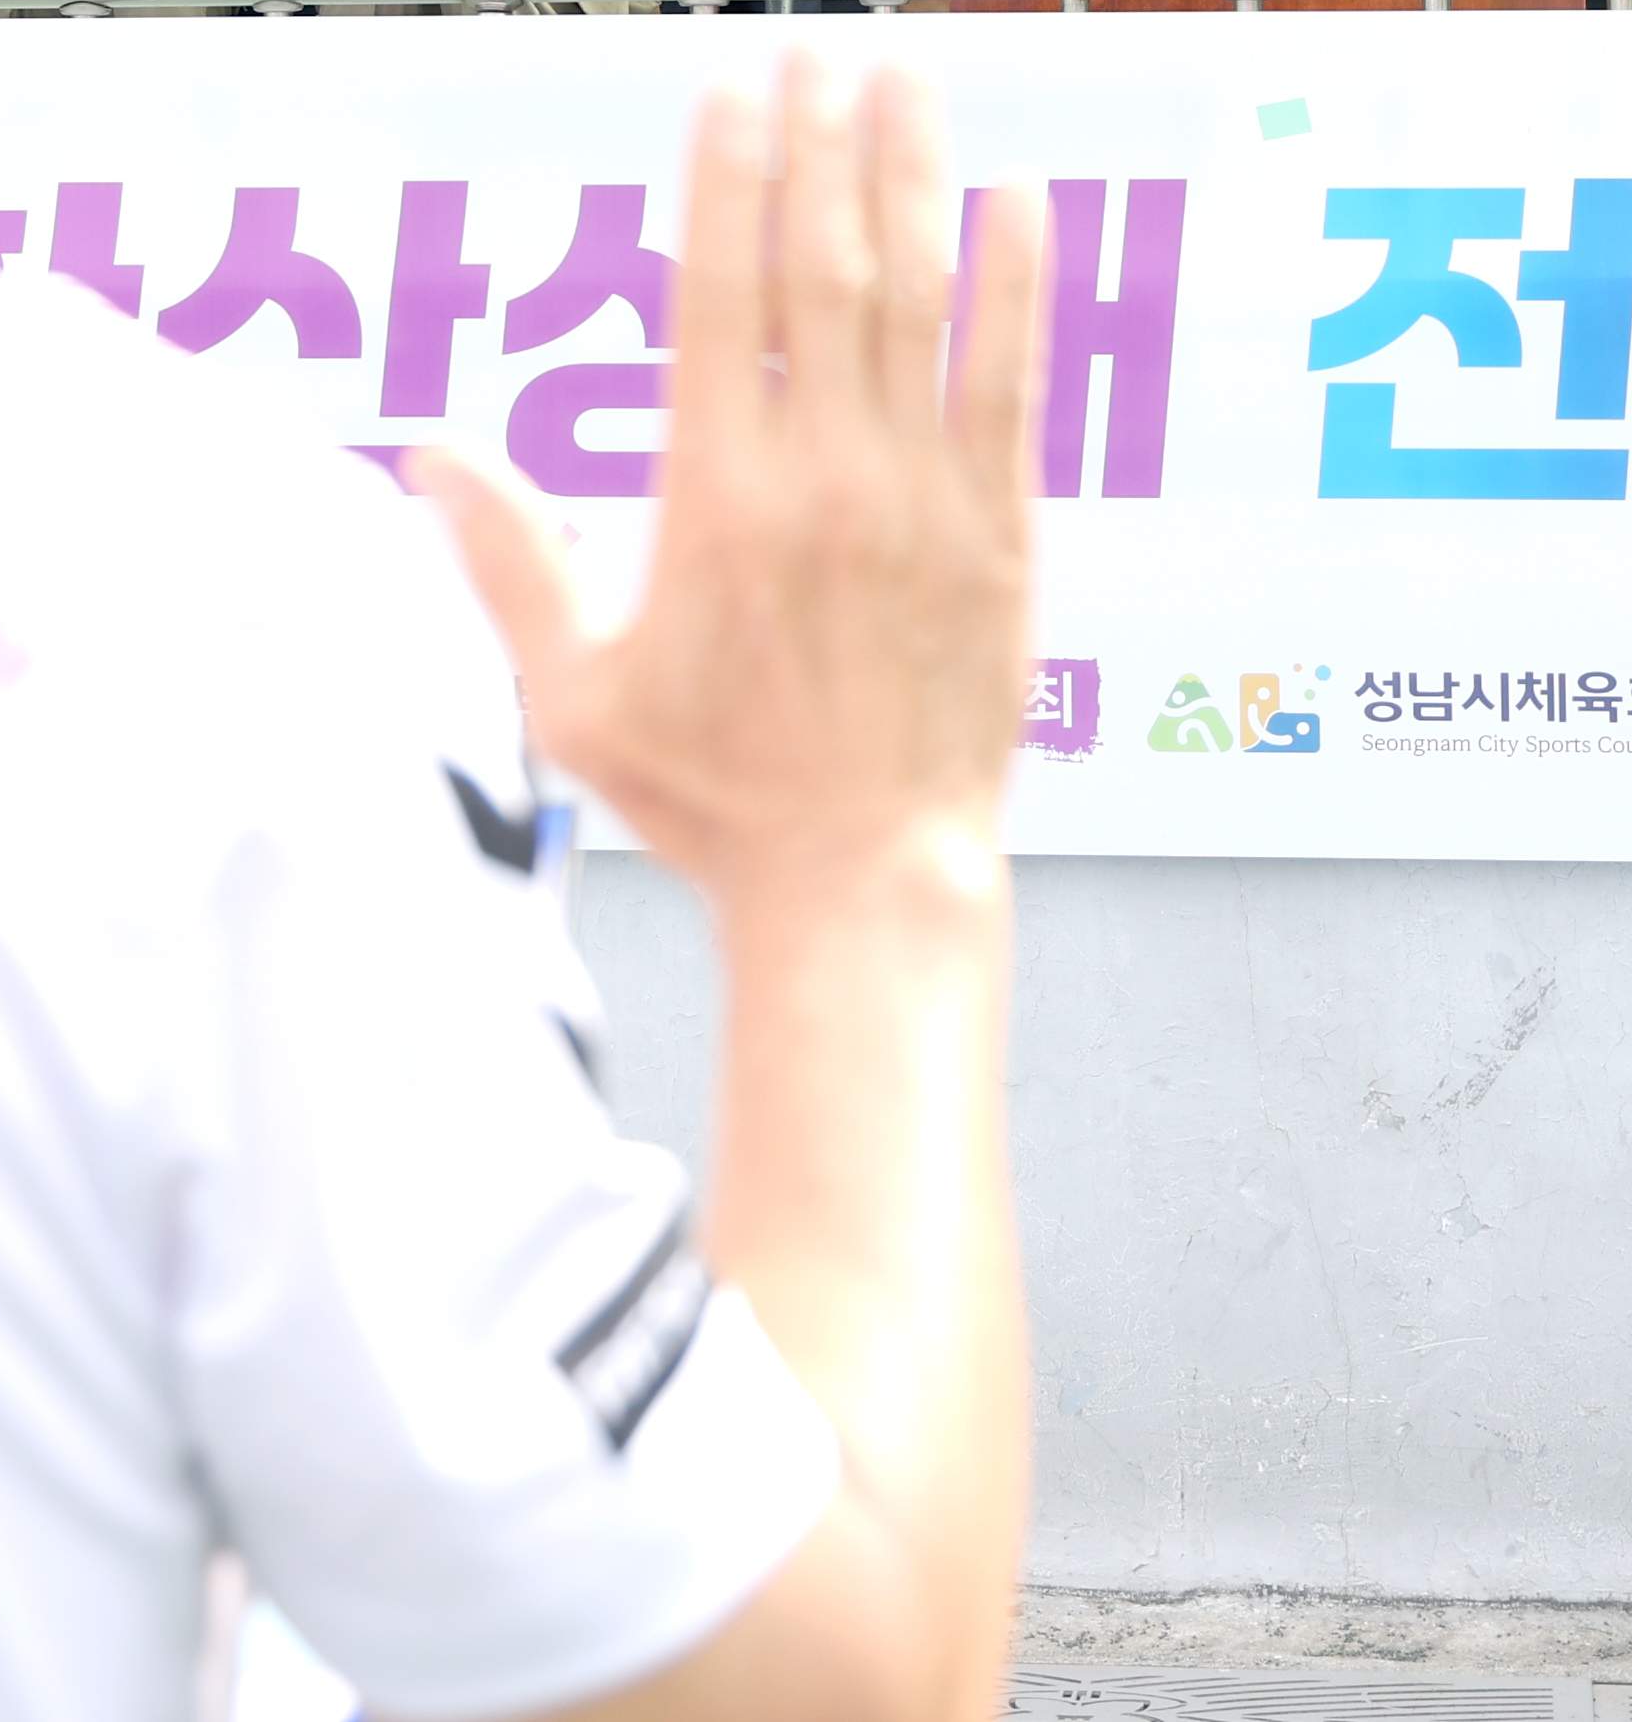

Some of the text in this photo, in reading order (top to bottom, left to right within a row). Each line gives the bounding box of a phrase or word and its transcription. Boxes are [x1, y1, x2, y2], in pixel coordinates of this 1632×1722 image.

[1361, 733, 1472, 757] Seongnam
[1478, 734, 1520, 757] City
[1525, 735, 1591, 757] Sports
